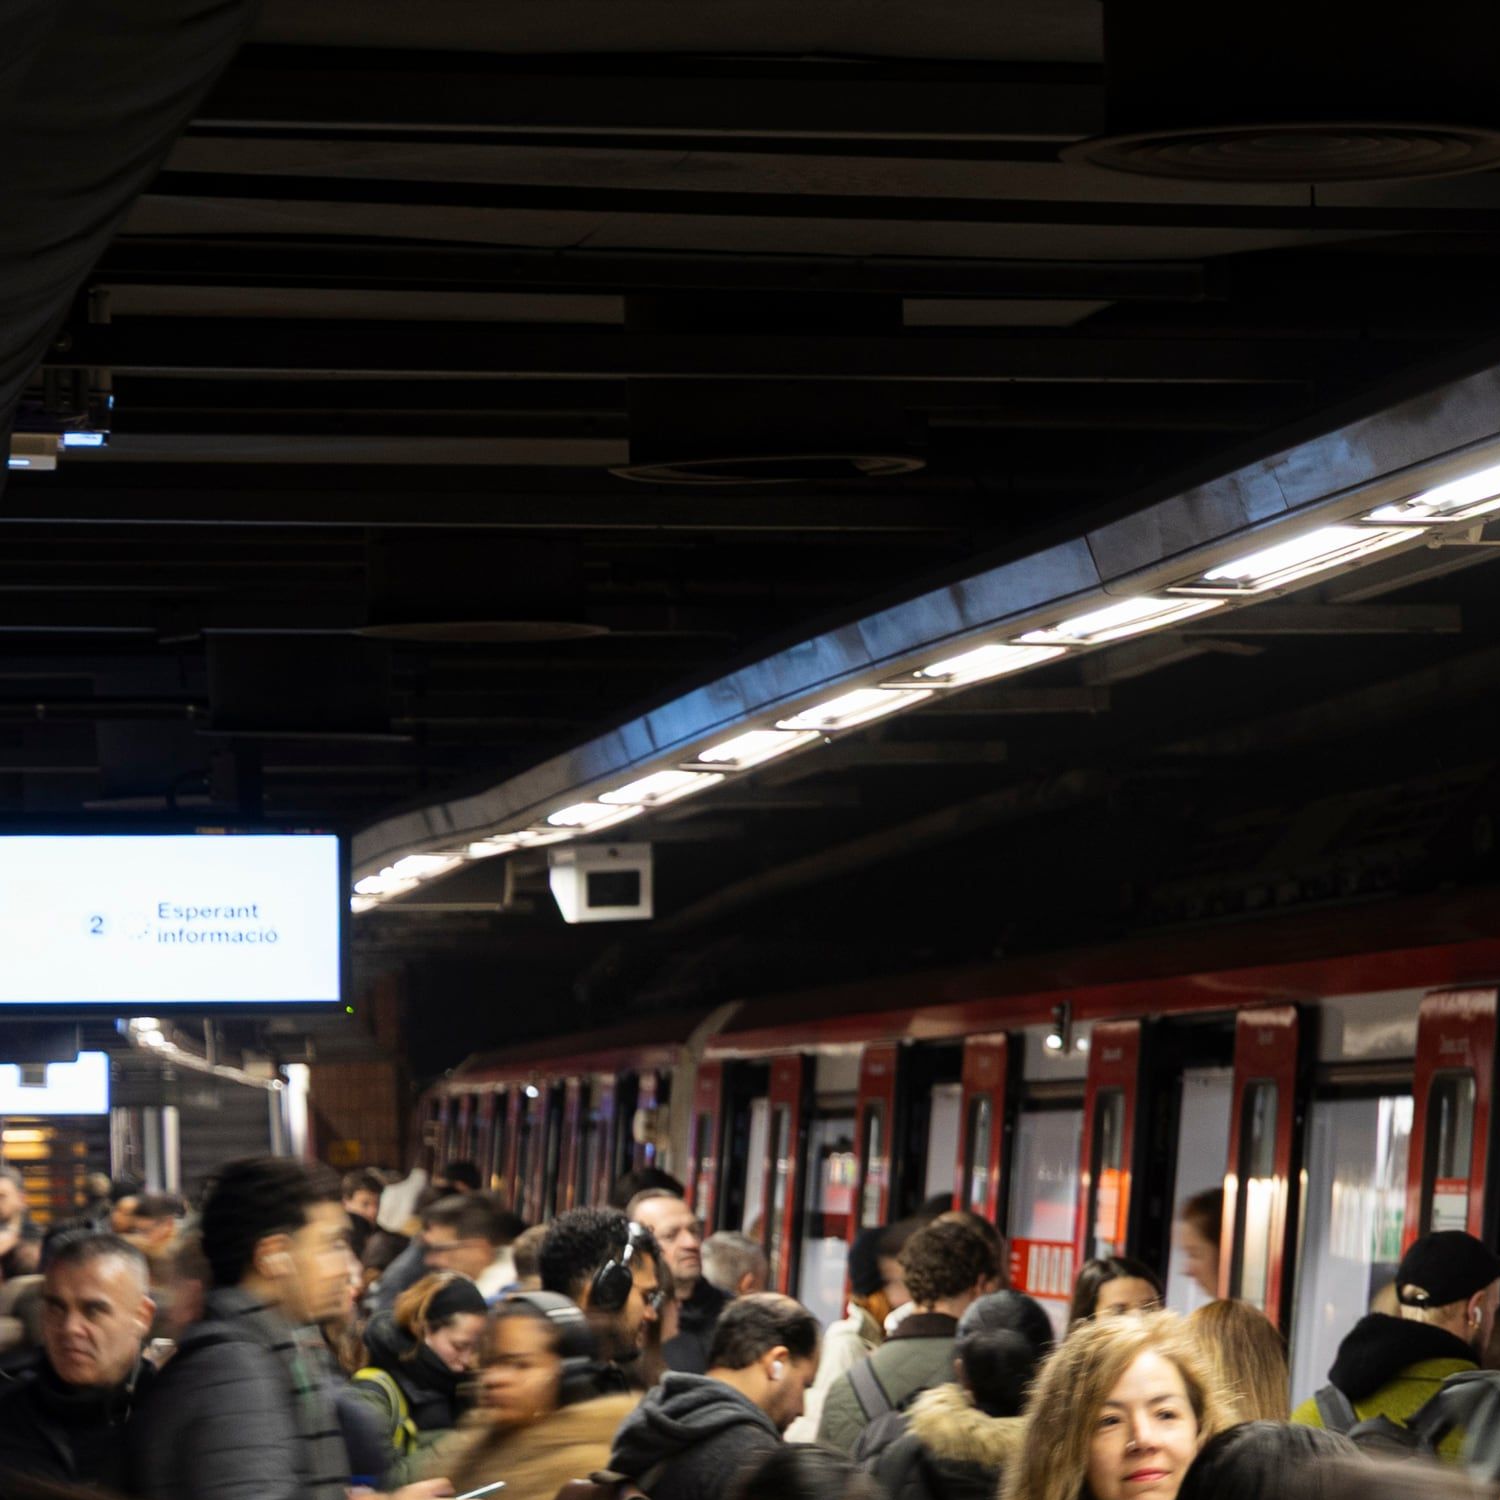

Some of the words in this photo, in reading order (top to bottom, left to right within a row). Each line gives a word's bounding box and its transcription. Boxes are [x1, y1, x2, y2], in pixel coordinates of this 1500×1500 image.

[157, 902, 259, 921] Esperant
[90, 915, 103, 935] 2
[157, 928, 278, 944] informació
